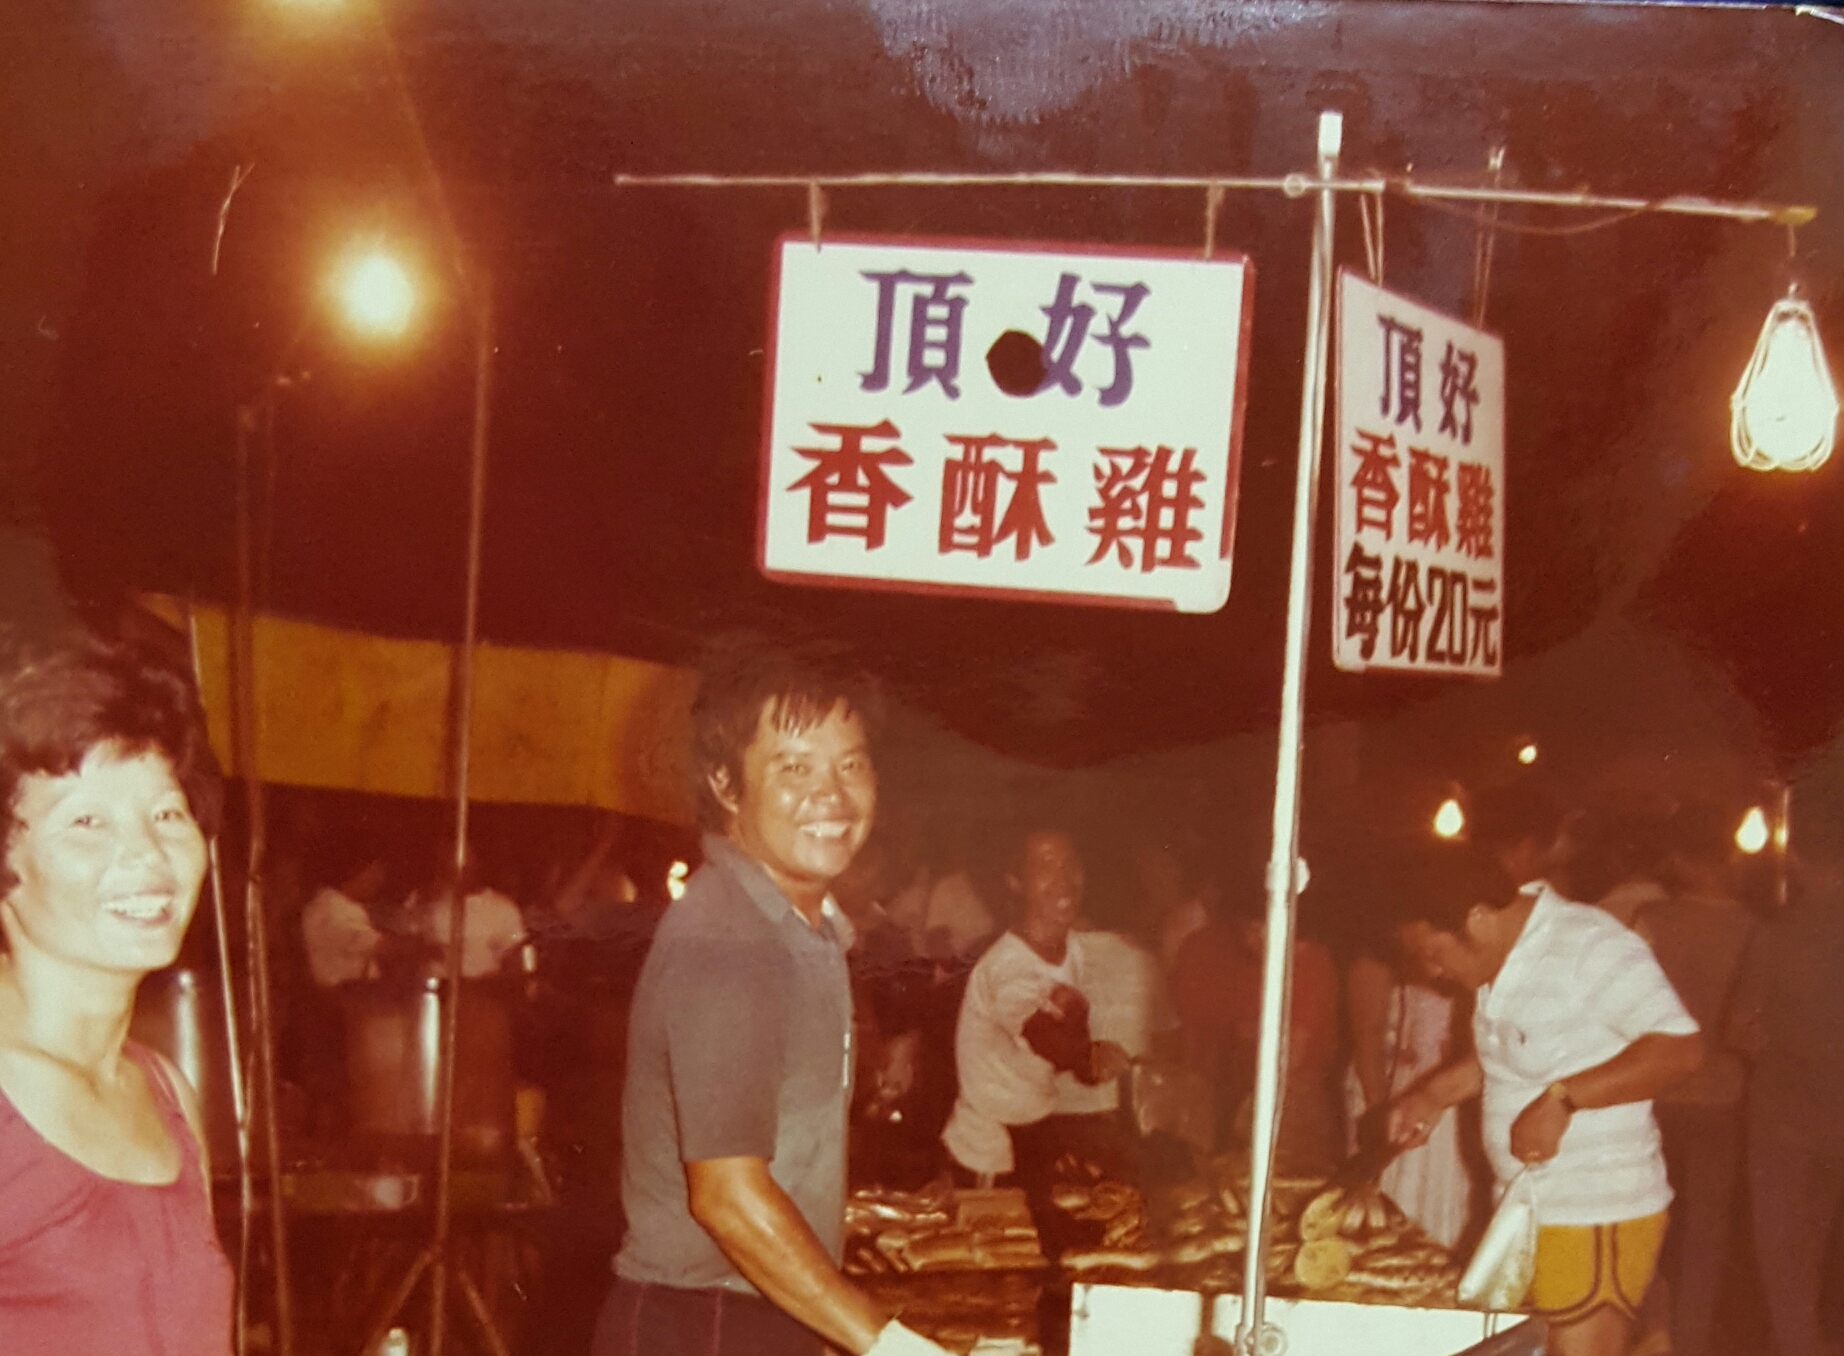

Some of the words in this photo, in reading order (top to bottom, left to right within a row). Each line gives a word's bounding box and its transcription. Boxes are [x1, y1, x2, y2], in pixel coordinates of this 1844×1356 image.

[857, 267, 1151, 408] 頂好
[1376, 314, 1481, 448] 頂好
[785, 418, 1207, 574] 香酥雞
[1350, 427, 1496, 562] 香酥雞
[1344, 540, 1500, 668] 每份20元
